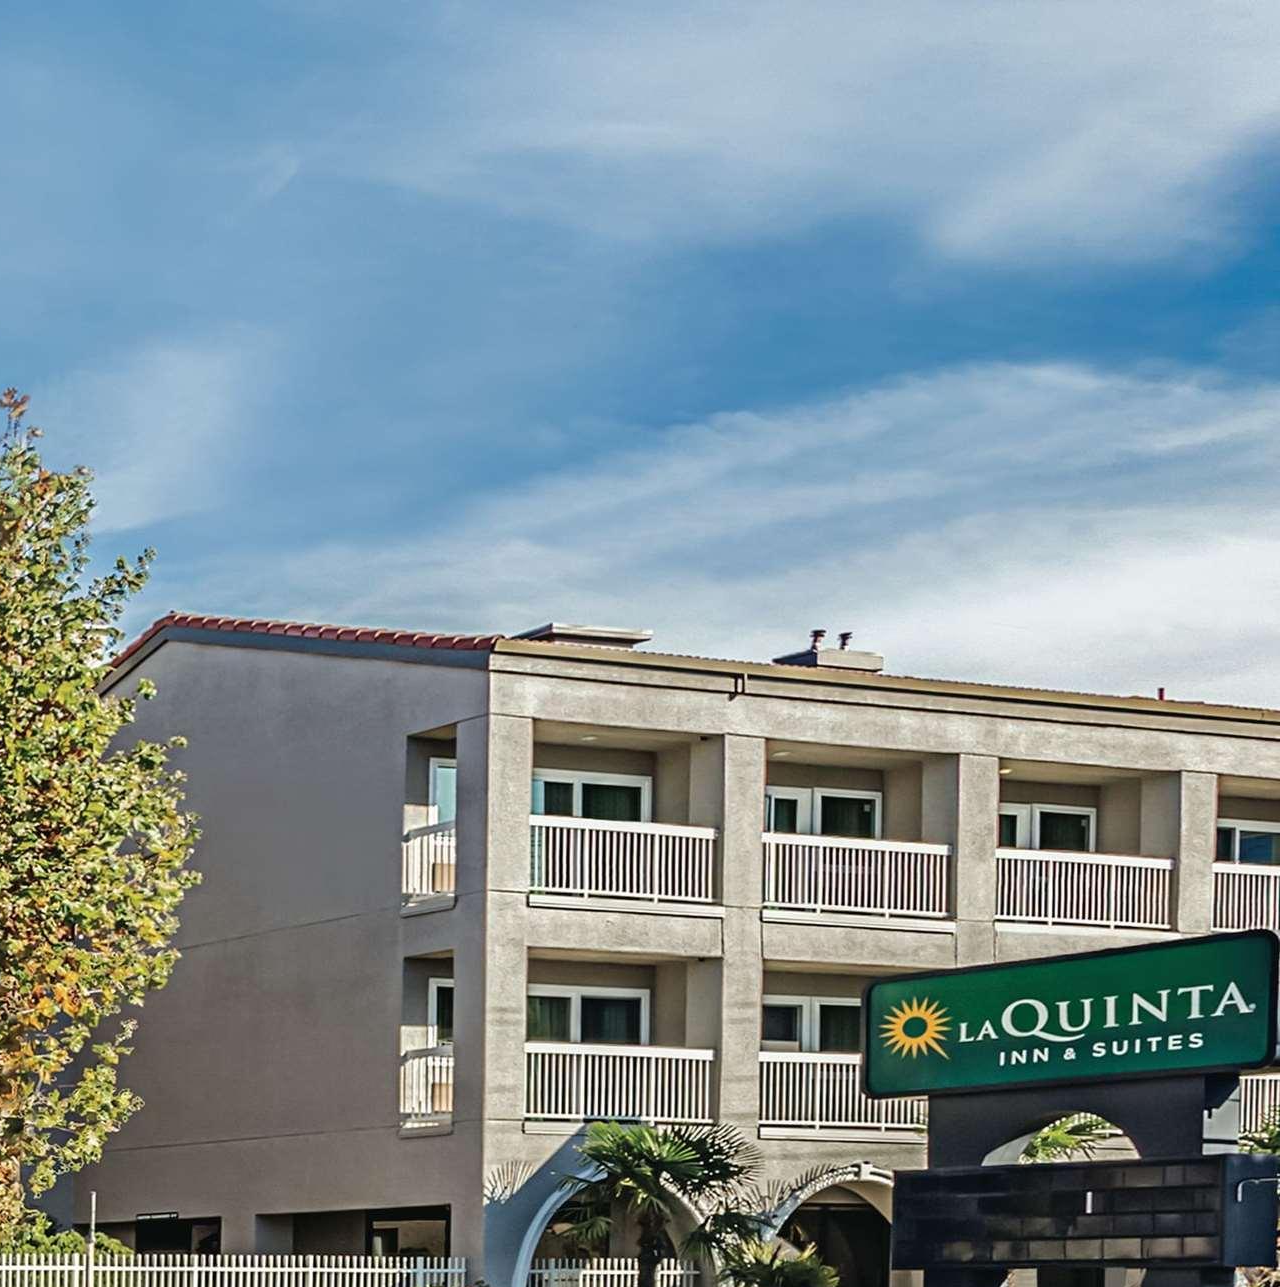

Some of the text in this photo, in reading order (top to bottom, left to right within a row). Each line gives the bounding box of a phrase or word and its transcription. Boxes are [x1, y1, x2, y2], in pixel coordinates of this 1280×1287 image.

[999, 1033, 1204, 1066] INN & SUITES
